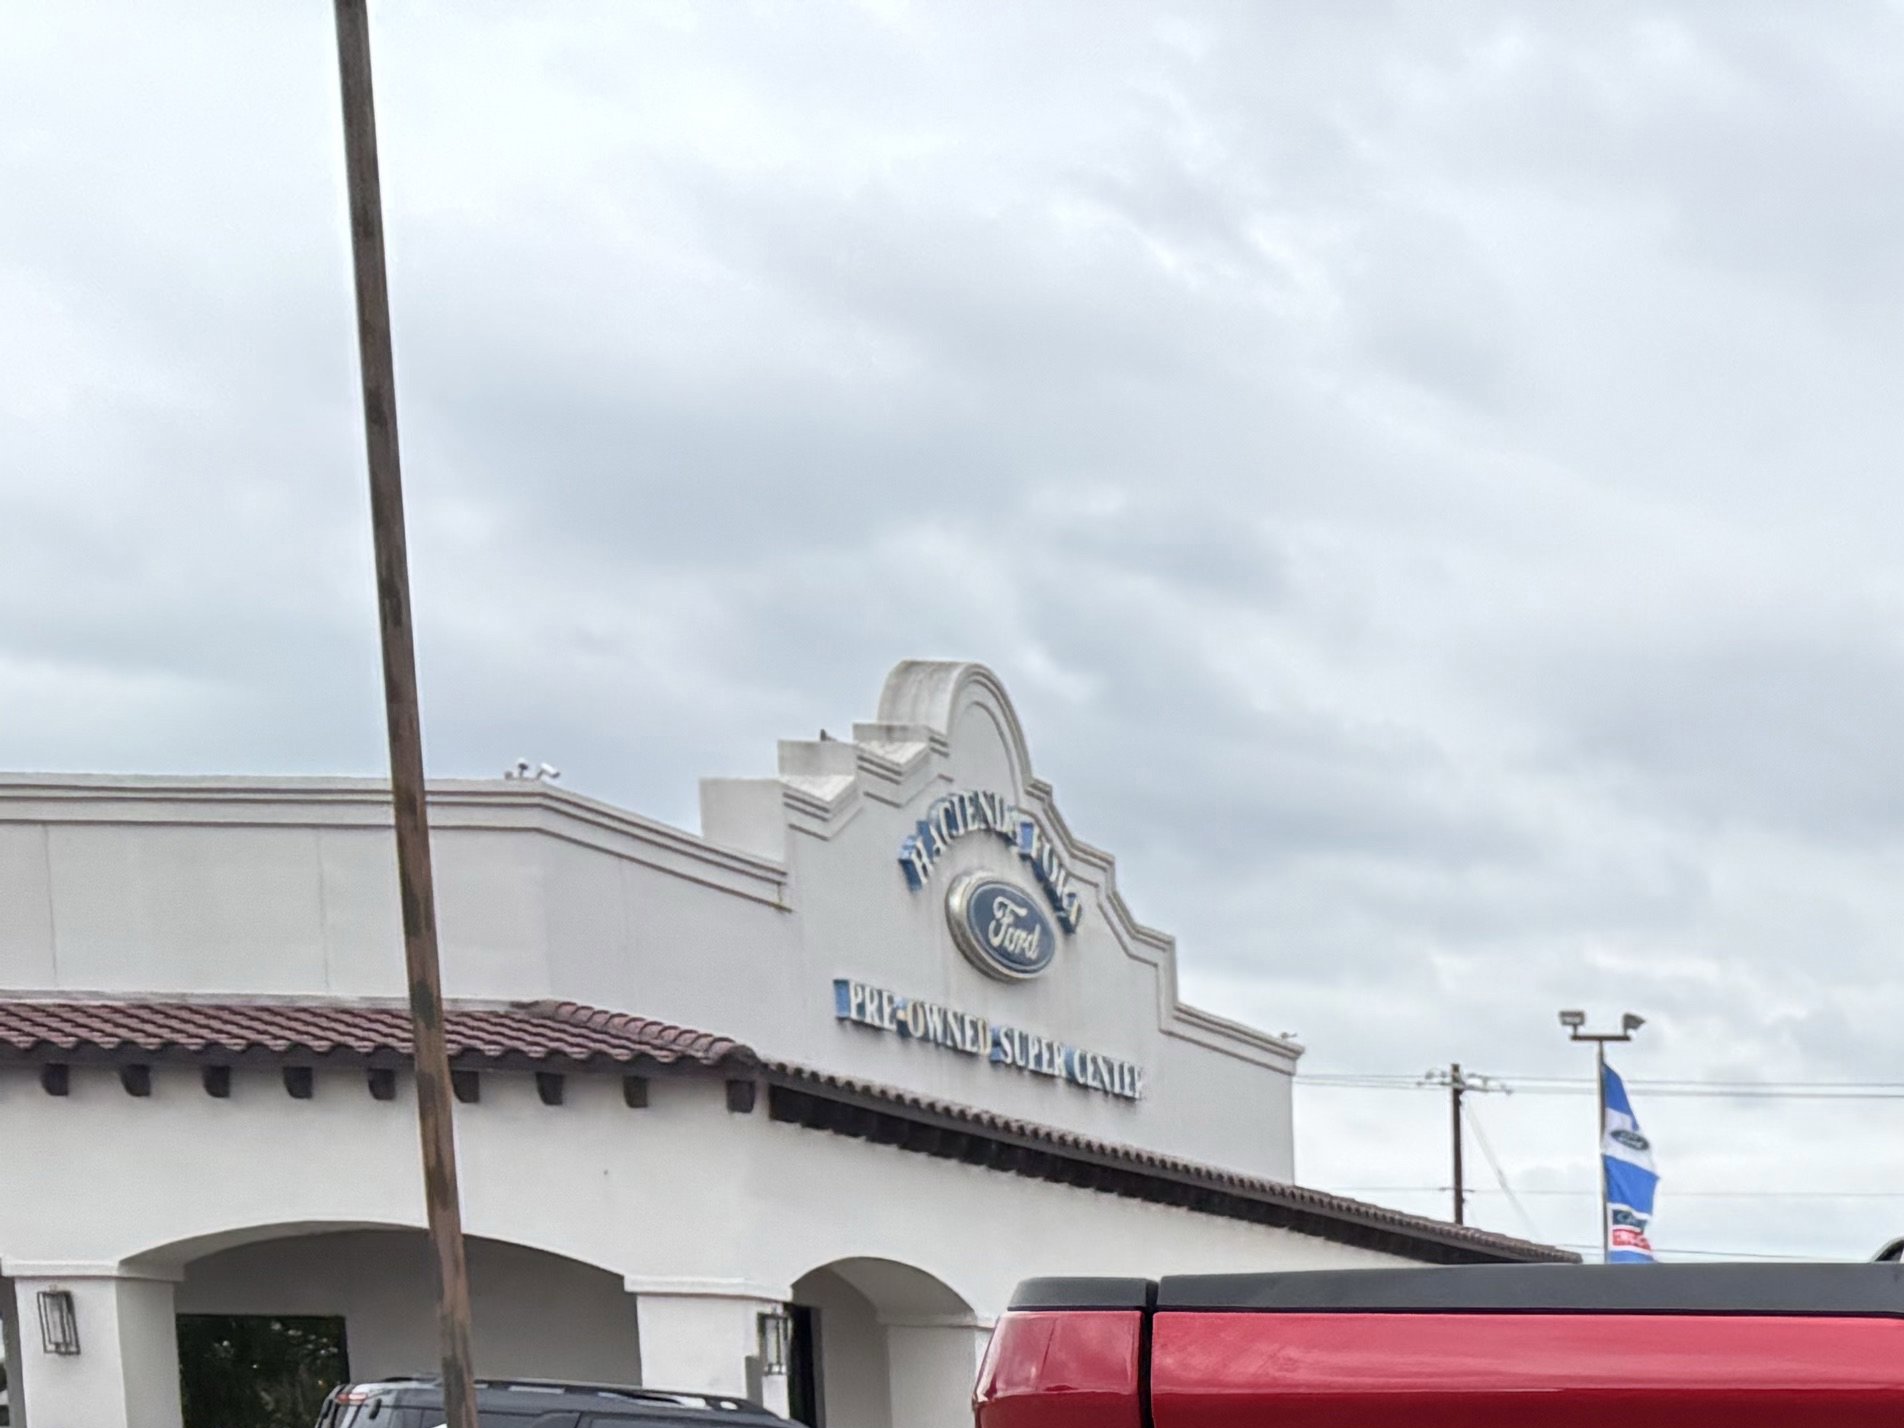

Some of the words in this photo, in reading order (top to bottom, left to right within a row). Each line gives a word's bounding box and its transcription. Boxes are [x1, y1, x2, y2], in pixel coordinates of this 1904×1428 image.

[988, 896, 1041, 960] Ford
[834, 979, 992, 1058] PRE-OWNED
[990, 1024, 1066, 1079] SUPER
[1063, 1045, 1145, 1102] CENTER
